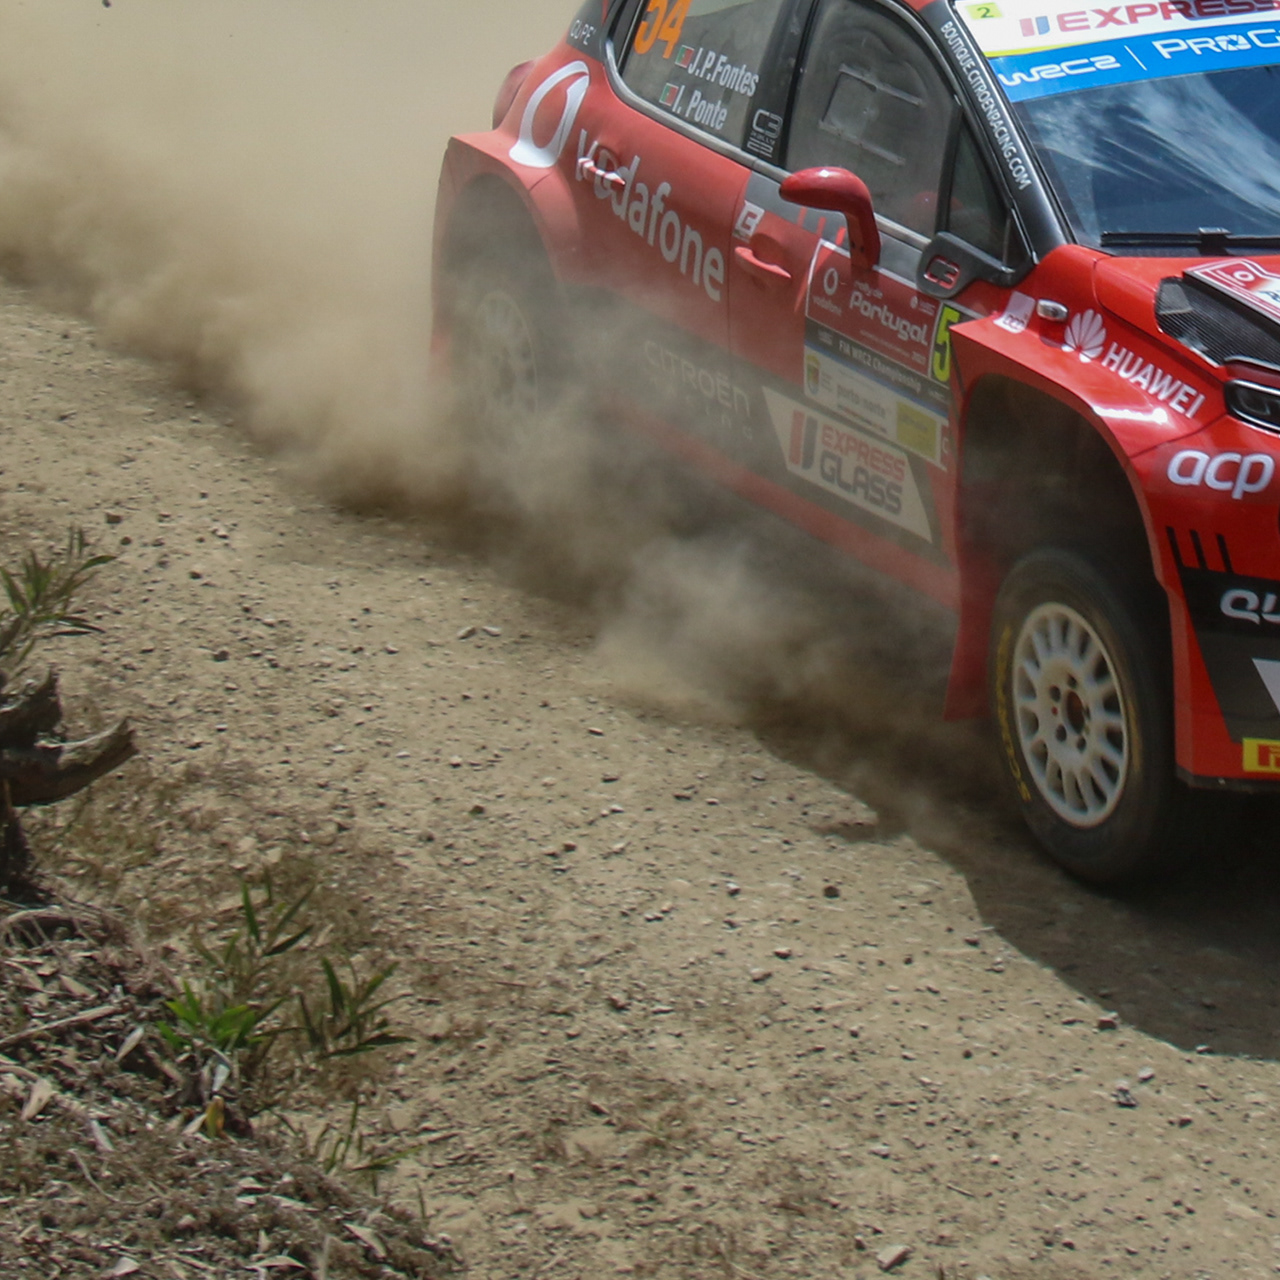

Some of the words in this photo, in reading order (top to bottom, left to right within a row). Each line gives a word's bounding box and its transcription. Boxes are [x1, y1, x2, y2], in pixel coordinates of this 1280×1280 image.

[977, 6, 995, 19] 2
[997, 54, 1121, 87] WRC2
[685, 89, 728, 131] Ponte
[752, 109, 784, 139] C3
[575, 128, 725, 302] vodafone
[923, 254, 962, 290] C3
[849, 291, 930, 347] Portugal
[1101, 341, 1206, 419] HUAWEI
[821, 423, 906, 482] EXPRESS
[1167, 449, 1276, 500] acp
[820, 450, 903, 516] GLASS
